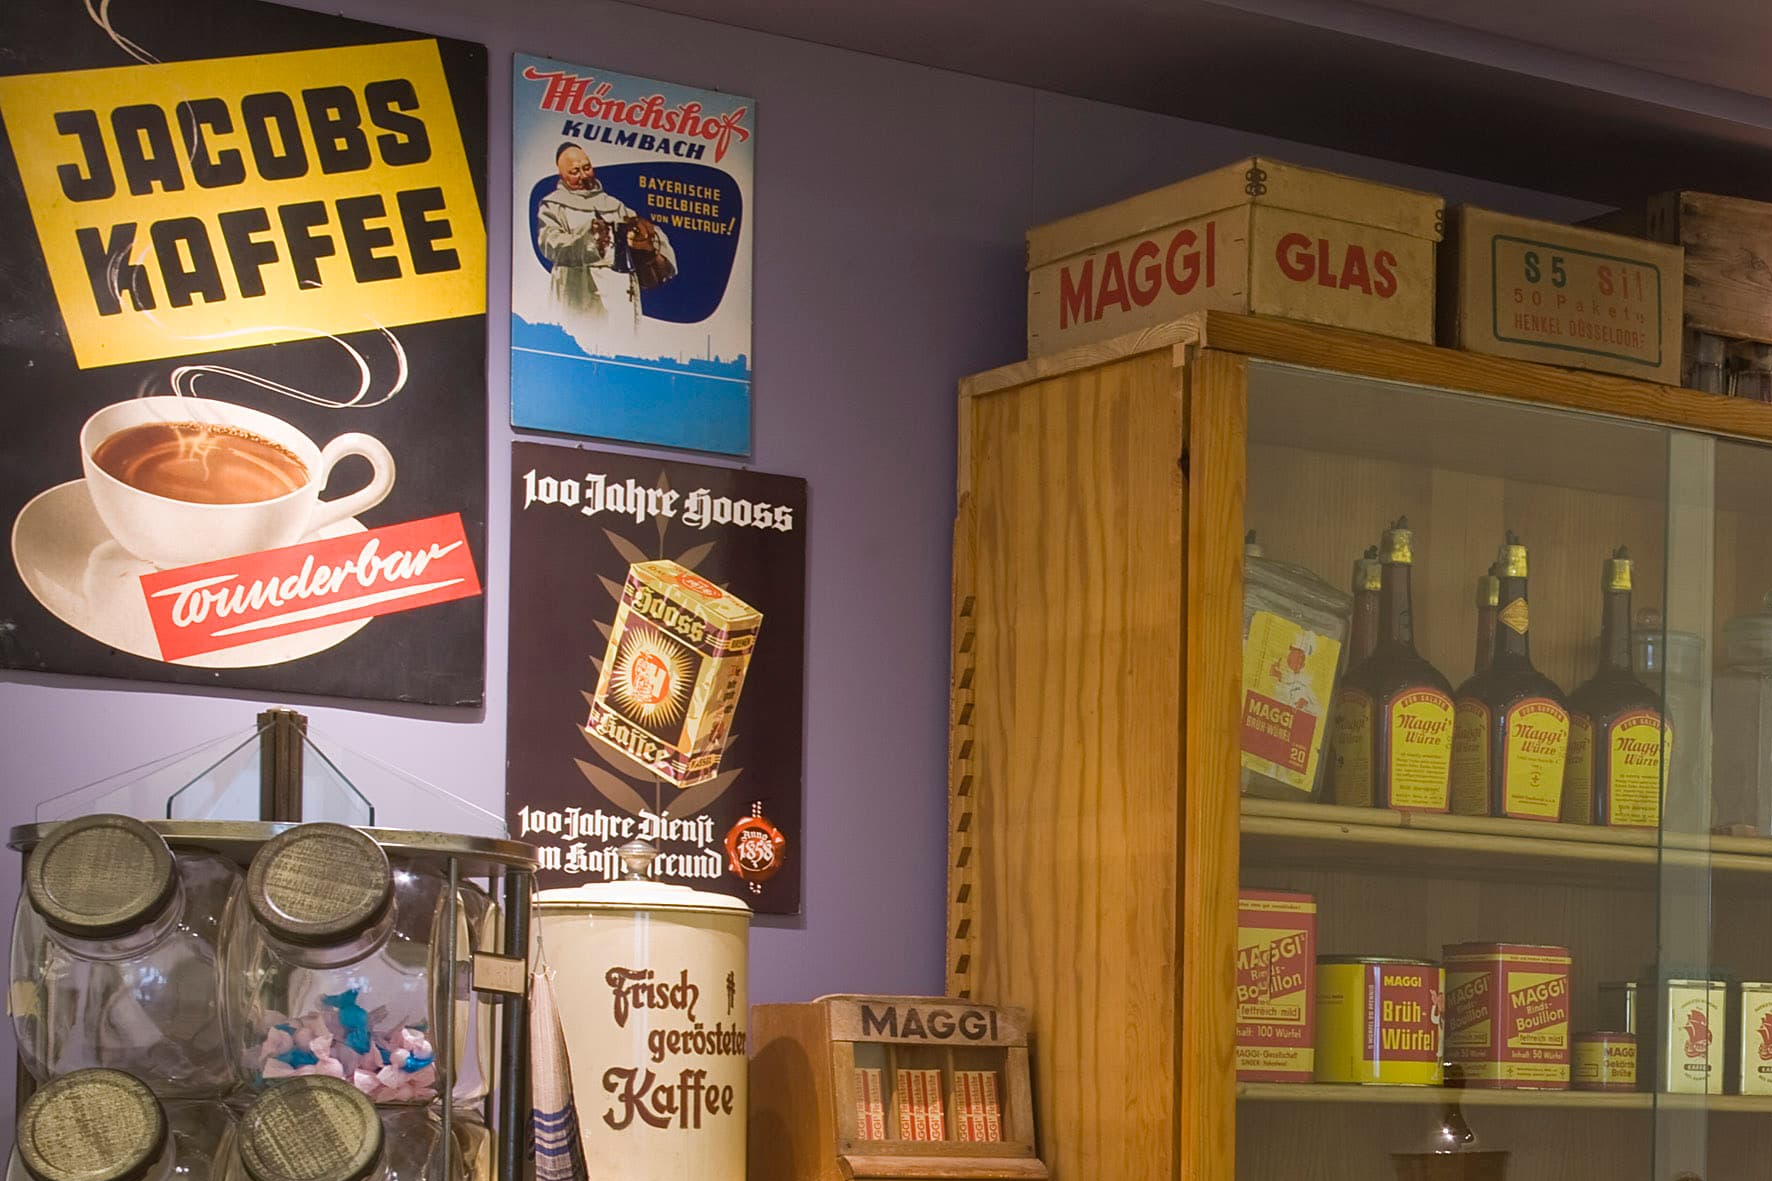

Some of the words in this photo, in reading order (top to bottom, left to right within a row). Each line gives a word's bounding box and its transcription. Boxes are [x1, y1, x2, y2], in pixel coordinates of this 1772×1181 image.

[523, 66, 749, 163] Mönchshof
[54, 78, 432, 202] JACOBS
[561, 119, 706, 160] KULMBACH
[639, 175, 721, 202] BAYERISCHE
[647, 193, 719, 217] EDELBIERE
[74, 186, 462, 318] KAFFEE
[1275, 232, 1399, 300] GLAS
[1058, 221, 1216, 330] MAGGI
[1555, 293, 1646, 324] Paket
[1514, 313, 1563, 335] HENKEL
[522, 468, 580, 510] 100
[581, 472, 681, 524] Jahre
[1249, 698, 1295, 729] MAGGI
[1405, 731, 1442, 746] Würze
[1521, 740, 1557, 756] Würze
[1290, 747, 1306, 764] 20
[517, 804, 562, 839] 100
[561, 806, 636, 843] Jahre
[637, 808, 716, 849] Dienst
[736, 839, 774, 864] 1858
[1383, 975, 1422, 987] MAGGI
[605, 967, 700, 1028] Frisch
[1280, 1006, 1298, 1018] mild
[1382, 1000, 1427, 1023] Brüh-
[860, 1004, 1000, 1042] MAGGI
[1257, 1025, 1273, 1038] 100
[1516, 1007, 1565, 1032] Bouillon
[648, 1022, 747, 1063] gerösteter
[1381, 1027, 1435, 1051] Würfel
[1532, 1049, 1543, 1060] 50
[602, 1066, 735, 1131] Kaffee
